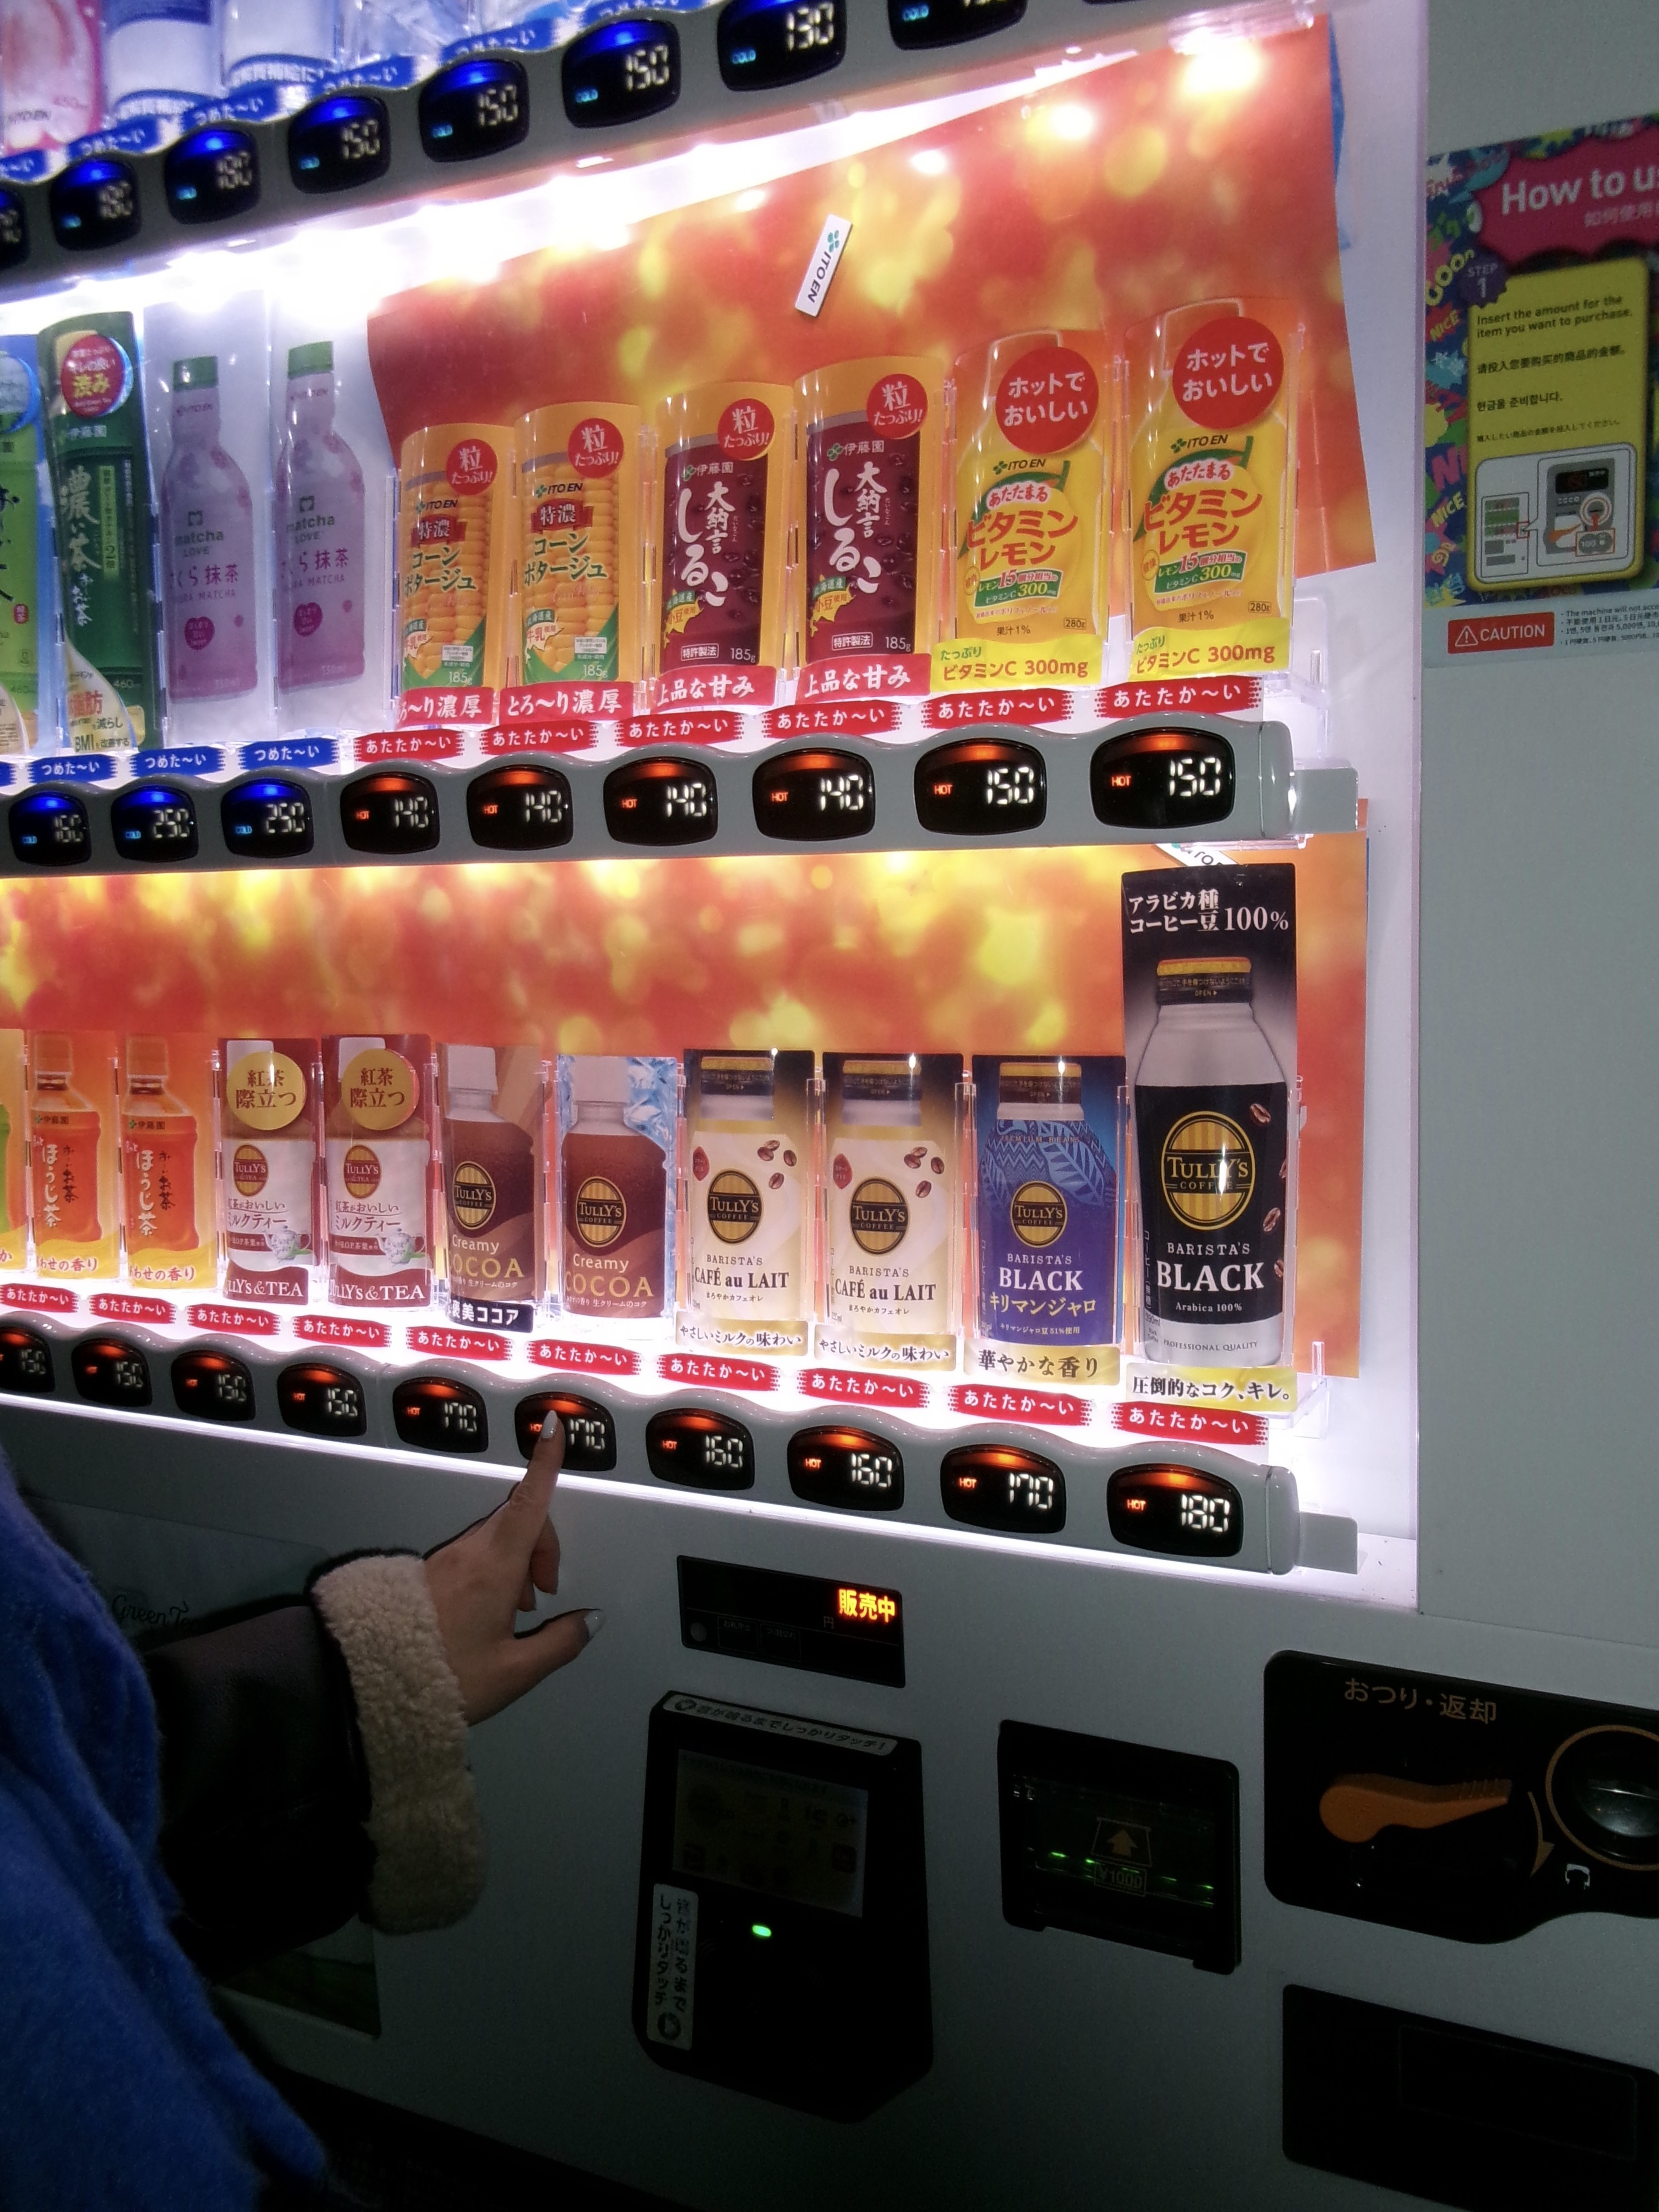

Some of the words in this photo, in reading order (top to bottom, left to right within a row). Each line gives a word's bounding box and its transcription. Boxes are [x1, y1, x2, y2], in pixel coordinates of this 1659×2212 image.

[786, 1, 835, 51] 150
[625, 45, 670, 92] 150
[478, 84, 519, 128] 150
[1500, 176, 1582, 215] How
[1590, 169, 1626, 199] to
[1467, 262, 1498, 277] STEP
[1477, 278, 1486, 298] 1
[1477, 314, 1511, 325] Insert
[1513, 309, 1532, 321] the
[1535, 303, 1580, 317] amount
[1583, 299, 1600, 311] for
[1604, 295, 1623, 307] the
[1477, 327, 1502, 338] item
[1505, 323, 1526, 336] you
[1528, 319, 1556, 330] want
[1559, 316, 1571, 326] to
[1574, 308, 1633, 325] purchase.
[1186, 341, 1269, 372] ホットで
[882, 381, 908, 410] 粒
[1008, 372, 1086, 399] ホットで
[1182, 370, 1273, 403] おいしい
[733, 407, 759, 433] 粒
[1004, 400, 1088, 427] おいしい
[582, 426, 606, 453] 粒
[844, 440, 884, 455] 伊藤園
[460, 446, 482, 471] 粒
[696, 462, 733, 475] 伊藤園
[1166, 463, 1231, 488] あたたまる
[855, 462, 887, 538] 大納言
[988, 483, 1048, 506] あたたまる
[540, 503, 576, 526] 特濃
[706, 481, 735, 554] 大納言
[1144, 487, 1263, 534] ビタミン
[285, 514, 335, 534] matcha
[417, 520, 450, 540] 特濃
[823, 468, 882, 594] しるこ
[967, 509, 1078, 549] ビタミン
[534, 533, 589, 556] コーン
[677, 488, 729, 607] しるこ
[1159, 523, 1240, 555] レモン
[413, 547, 460, 568] コーン
[979, 541, 1057, 571] レモン
[404, 569, 477, 598] ポタージュ
[523, 558, 608, 586] ポタージュ
[833, 634, 871, 648] 特許製法
[884, 636, 912, 652] 185g
[1480, 624, 1545, 641] CAUTION
[682, 646, 717, 658] 特許製法
[730, 647, 756, 662] 185g
[940, 646, 983, 660] たっぷり
[1136, 636, 1165, 654] たっぷり
[583, 663, 608, 679] 185g
[944, 660, 1017, 681] ビタミンC
[1024, 659, 1088, 678] 300mg
[1136, 649, 1201, 674] ビタミンC
[1208, 646, 1275, 667] 300mg
[448, 670, 473, 685] 185g
[804, 665, 911, 698] 上品な甘み
[507, 689, 622, 716] とろ〜り濃厚
[657, 677, 756, 706] 上品な甘み
[934, 783, 953, 795] HOT
[987, 766, 1034, 805] 150
[1111, 775, 1132, 787] HOT
[1169, 757, 1221, 797] 150
[622, 798, 638, 808] HOT
[666, 782, 707, 818] 140
[771, 792, 789, 803] HOT
[819, 774, 864, 812] 140
[394, 796, 429, 829] 140
[484, 804, 498, 815] HOT
[525, 790, 562, 823] 140
[1128, 889, 1219, 914] アラビカ種
[1129, 911, 1220, 934] コーヒー豆
[1224, 906, 1289, 931] 100%
[247, 1069, 284, 1086] 紅茶
[360, 1068, 393, 1085] 紅茶
[236, 1090, 296, 1108] 際立つ
[350, 1090, 405, 1108] 際立つ
[42, 1143, 62, 1228] ほうじ茶
[136, 1149, 158, 1236] ほうじ茶
[335, 1201, 399, 1213] 紅茶がおいしい
[228, 1214, 287, 1229] ミルクティー
[334, 1216, 402, 1232] ミルクティー
[860, 1222, 894, 1230] COFFEE
[451, 1235, 500, 1254] Creamy
[1167, 1242, 1250, 1256] BARISTA'S
[573, 1253, 629, 1273] Creamy
[707, 1254, 763, 1266] BARISTA'S
[1007, 1253, 1072, 1265] BARISTA'S
[694, 1267, 722, 1286] CAFÉ
[725, 1276, 743, 1288] au
[747, 1272, 789, 1289] LAIT
[849, 1265, 909, 1278] BARISTA'S
[999, 1267, 1083, 1291] BLACK
[1156, 1260, 1265, 1291] BLACK
[564, 1270, 654, 1298] COCOA
[835, 1278, 865, 1299] CAFÉ
[869, 1288, 889, 1301] au
[893, 1284, 937, 1302] LAIT
[593, 1300, 647, 1308] 生クリームのコク
[706, 1292, 764, 1302] まろやかカフェオレ
[849, 1304, 910, 1314] まろやかカフェオレ
[989, 1291, 1097, 1317] キリマンジャロ
[1175, 1302, 1213, 1312] Arabica
[1216, 1303, 1243, 1312] 100%
[680, 1325, 802, 1346] やさしいミルクの味わい
[1163, 1339, 1220, 1351] PROFESSIONAL
[1223, 1341, 1258, 1351] QUALITY
[818, 1338, 949, 1361] やさしいミルクの味わい
[978, 1349, 1099, 1378] 華やかな香り
[1132, 1376, 1291, 1400] 圧倒的なコク、キレ。
[407, 1407, 421, 1416] HOT
[662, 1440, 677, 1450] HOT
[705, 1435, 743, 1468] 160
[805, 1458, 821, 1469] HOT
[852, 1452, 892, 1488] 160
[959, 1477, 976, 1489] HOT
[1009, 1472, 1053, 1510] 170
[1126, 1499, 1146, 1511] HOT
[1181, 1494, 1230, 1533] 180
[111, 1594, 167, 1626] Green
[838, 1589, 896, 1623] 販売中
[1343, 1678, 1498, 1724] おつり・返却
